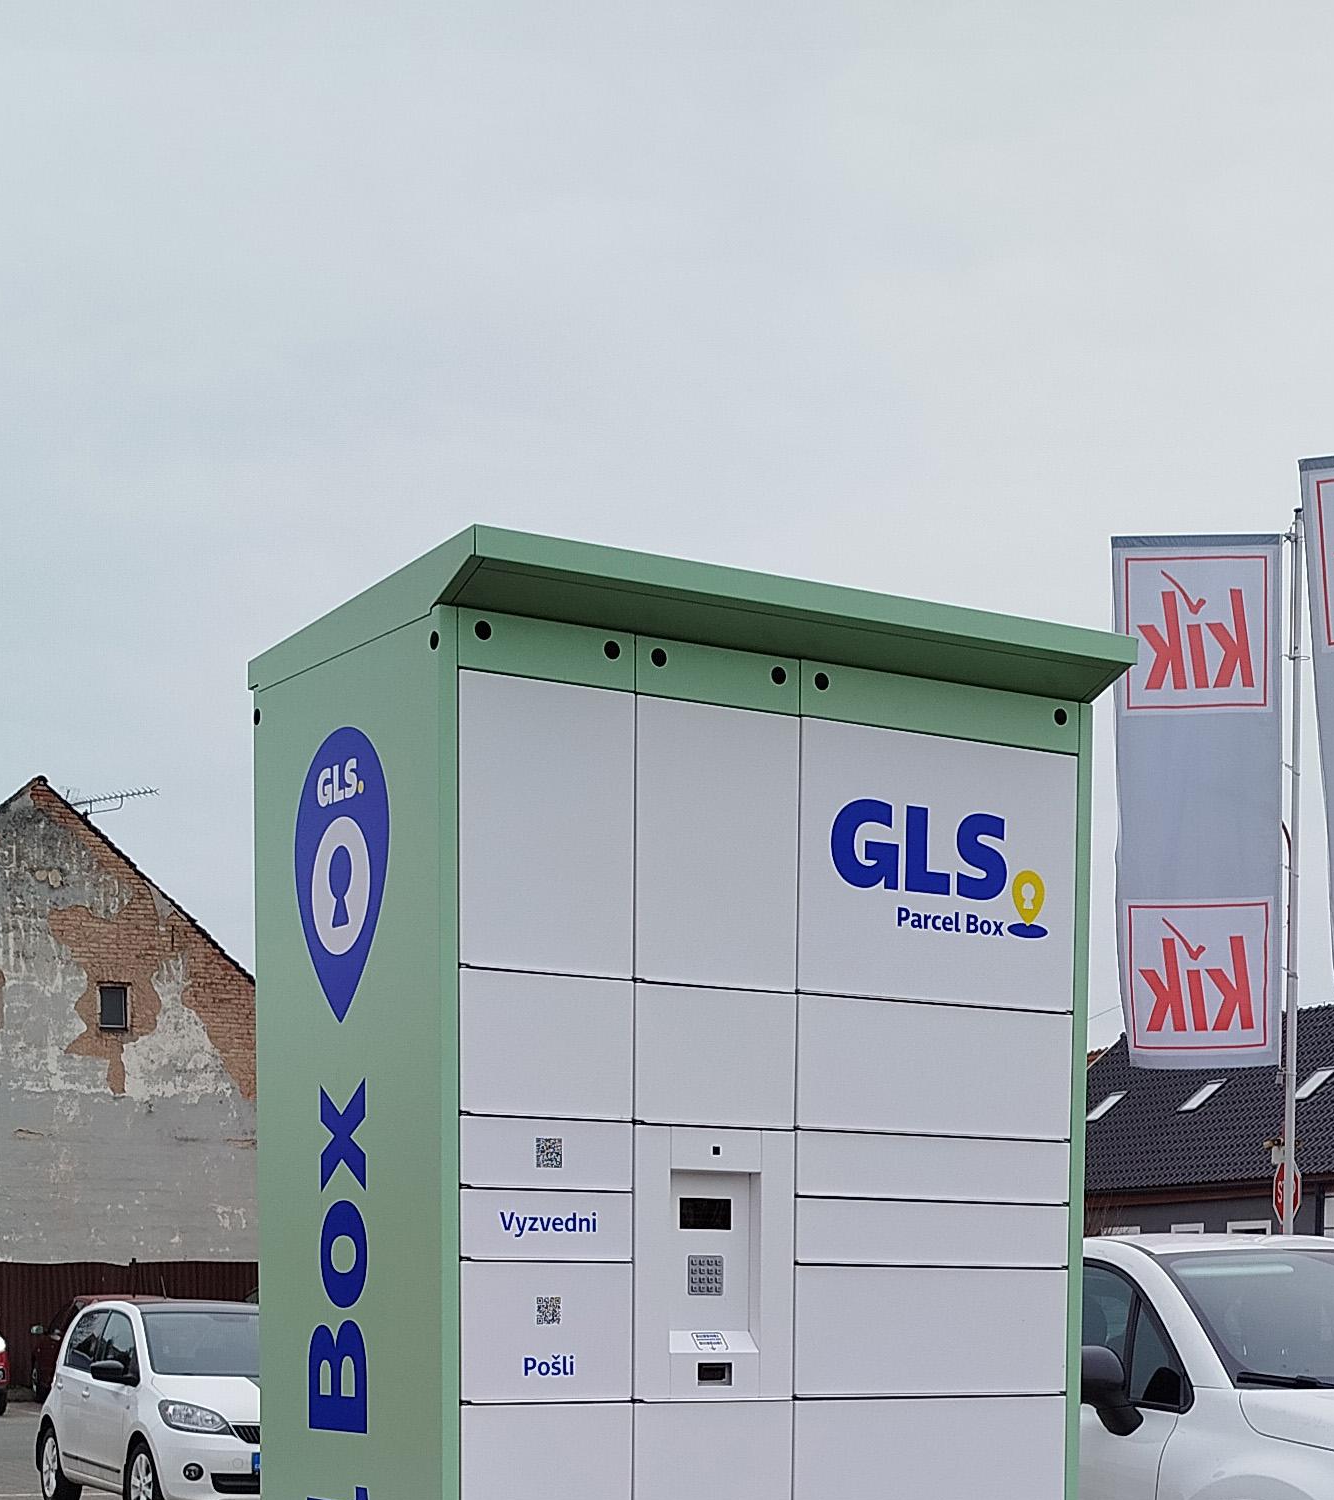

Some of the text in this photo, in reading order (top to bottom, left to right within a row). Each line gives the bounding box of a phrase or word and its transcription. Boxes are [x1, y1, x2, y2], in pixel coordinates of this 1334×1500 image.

[897, 907, 1005, 936] Parcel Box
[499, 1211, 598, 1238] Vyzvedni
[308, 1077, 369, 1436] Box
[523, 1354, 575, 1377] Pošli
